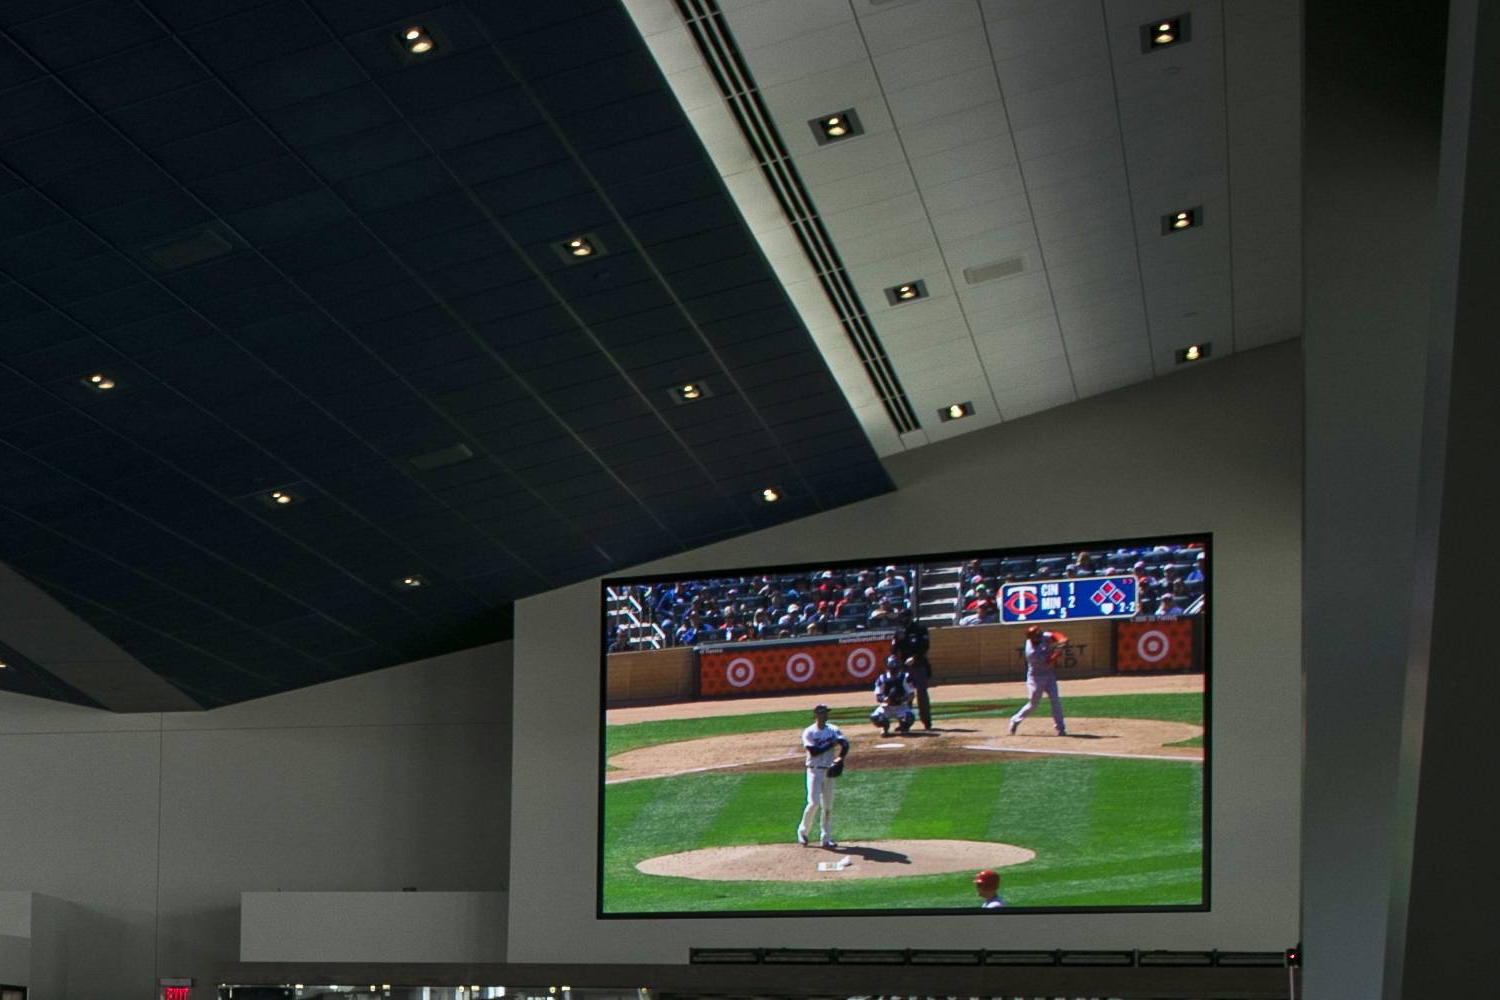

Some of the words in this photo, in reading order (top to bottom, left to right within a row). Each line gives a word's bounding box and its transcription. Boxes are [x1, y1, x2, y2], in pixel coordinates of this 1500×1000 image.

[1040, 584, 1059, 596] CIN
[1068, 582, 1075, 595] 1
[1041, 596, 1062, 610] MIN
[1068, 596, 1076, 608] 2
[1060, 607, 1068, 619] 5
